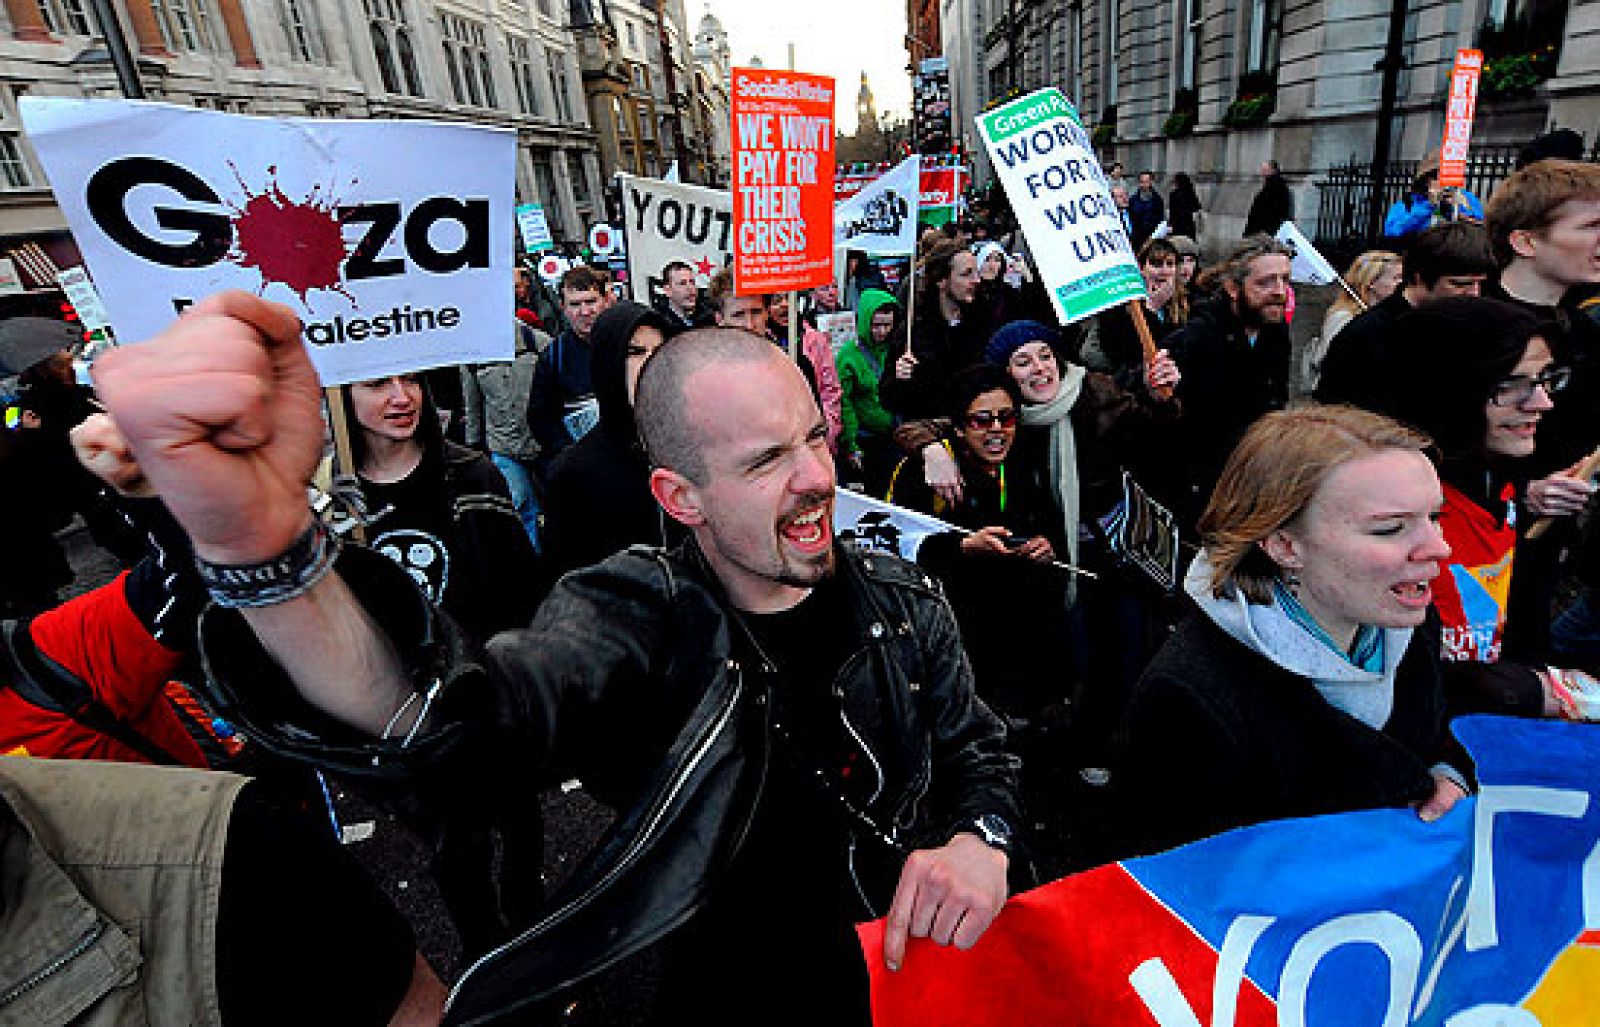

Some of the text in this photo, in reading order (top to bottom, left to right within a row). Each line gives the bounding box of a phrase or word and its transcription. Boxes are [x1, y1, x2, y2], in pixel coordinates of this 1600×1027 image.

[737, 113, 831, 152] WE WON'T
[994, 102, 1051, 133] Green
[738, 150, 818, 184] PAY FOR
[1025, 159, 1086, 198] FOR
[738, 185, 801, 219] THEIR
[740, 218, 807, 254] CRISIS
[301, 304, 461, 346] alestine
